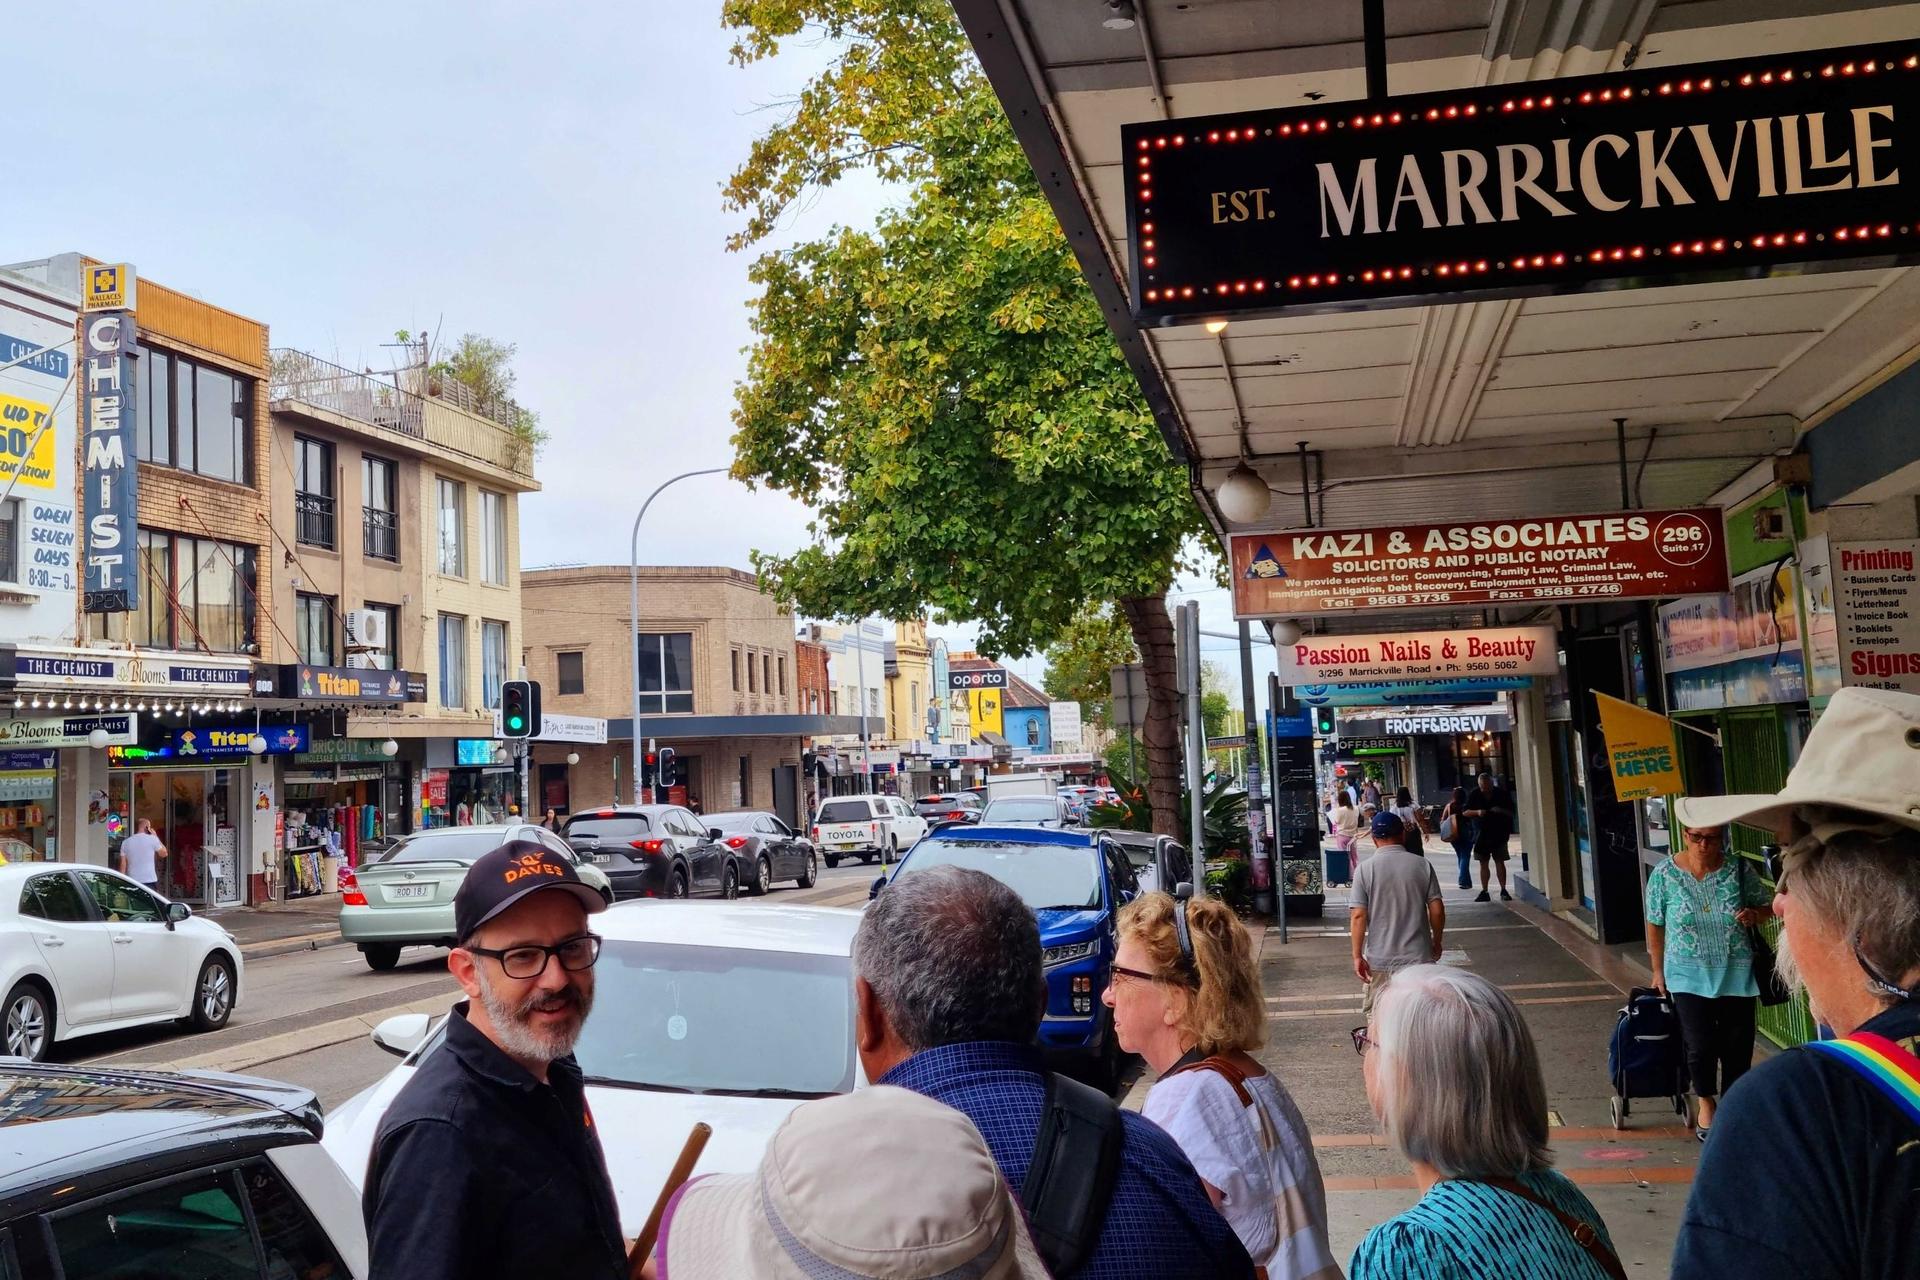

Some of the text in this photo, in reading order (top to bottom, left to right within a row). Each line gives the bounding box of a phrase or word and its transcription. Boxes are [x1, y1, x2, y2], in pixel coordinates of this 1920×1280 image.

[1211, 105, 1900, 239] EST. MARRICKVILLE
[88, 300, 122, 309] PHARMACY
[89, 293, 121, 301] WALLACES
[10, 342, 63, 373] CHEMIST
[3, 404, 29, 422] UP
[86, 317, 125, 589] CHEMIST
[0, 459, 50, 480] EDICATION
[33, 506, 73, 524] OPEN
[31, 527, 74, 546] SEVEN
[1292, 515, 1650, 560] KAZI & ASSOCIATES
[1662, 526, 1702, 543] 296
[1662, 544, 1689, 552] Suite
[34, 548, 70, 567] DAYS
[1332, 547, 1610, 573] SOLICITORS AND PUBLIC NOTARY
[1841, 549, 1914, 573] Printing
[1285, 561, 1636, 588] We provide services for: Conveyancing, Family Law, Criminal Law,
[1850, 574, 1916, 584] Business Cards
[1269, 570, 1668, 599] Immigration Litigation, Debt Recovery, Employment law, Business Law, etc.
[1852, 588, 1908, 597] Flyers/Menus
[1323, 584, 1620, 608] Tel: 9568 3736 Fax: 9568 4746
[1853, 600, 1900, 609] Letterhead
[1854, 611, 1909, 621] Invoice Book
[1855, 625, 1893, 633] Booklets
[1856, 637, 1900, 645] Envelopes
[1295, 635, 1536, 666] Passion Nails & Beauty
[28, 659, 239, 684] THE CHEMIST Blooms THE CHEMIST
[1318, 660, 1518, 679] 3/296 Marrickville Road Ph: 9560 5062
[1851, 650, 1920, 678] Signs
[317, 672, 360, 697] Titan
[953, 672, 1002, 687] oporto
[1884, 681, 1901, 689] Box
[10, 721, 62, 738] Blooms
[65, 723, 83, 732] THE
[1385, 715, 1487, 734] FROFF&BREW
[1340, 738, 1406, 749] OFF&BREW
[1614, 745, 1670, 760] RECHARGE
[1616, 755, 1674, 777] HERE
[430, 787, 446, 799] SALE
[827, 830, 864, 840] TOYOTA
